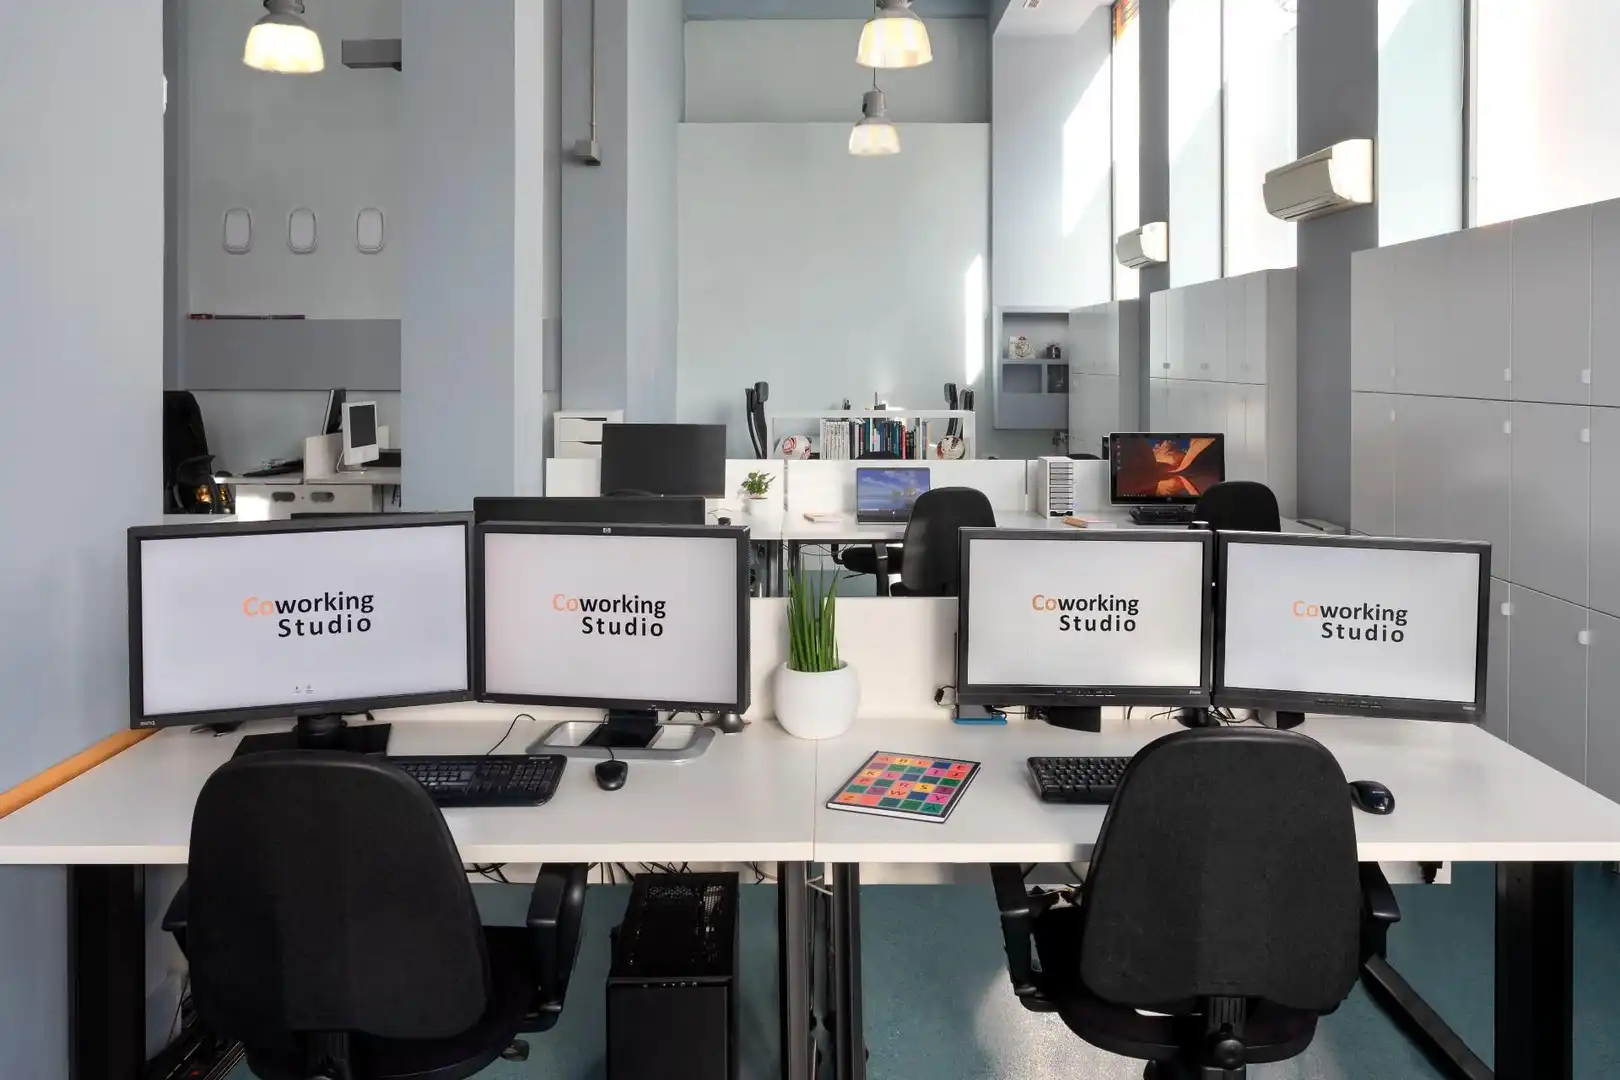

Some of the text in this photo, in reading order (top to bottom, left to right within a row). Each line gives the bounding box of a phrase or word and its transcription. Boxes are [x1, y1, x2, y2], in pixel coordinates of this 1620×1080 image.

[242, 591, 374, 616] Coworking
[553, 594, 666, 619] Coworking
[1032, 594, 1139, 616] Coworking
[1292, 600, 1408, 626] Coworking
[278, 614, 371, 638] Studio
[581, 617, 663, 637] Studio
[1059, 614, 1136, 632] Studio
[1321, 622, 1404, 643] Studio
